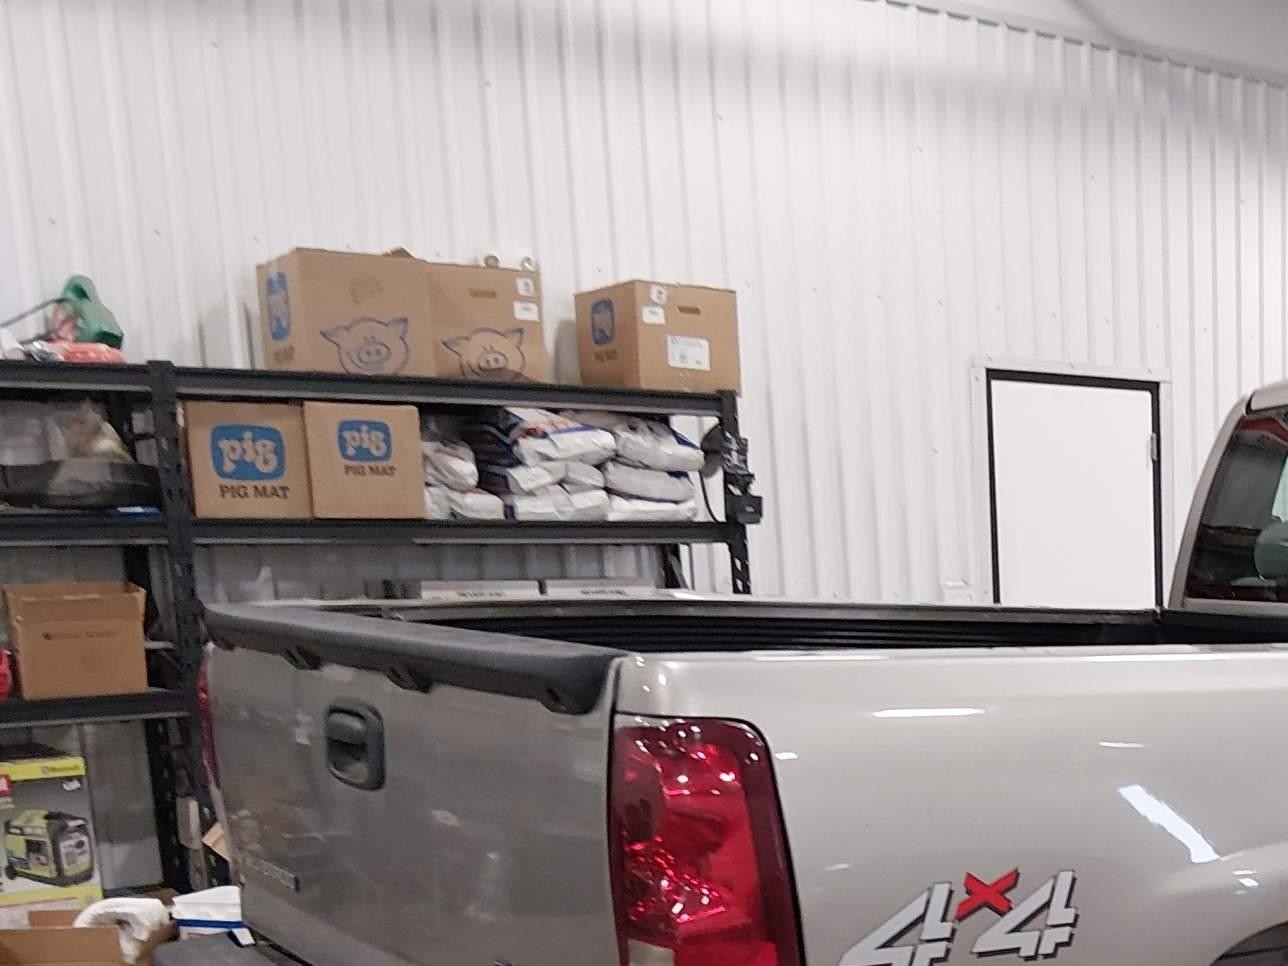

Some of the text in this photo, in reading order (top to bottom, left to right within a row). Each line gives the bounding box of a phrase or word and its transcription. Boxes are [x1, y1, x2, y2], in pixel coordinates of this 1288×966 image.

[217, 430, 279, 474] pig
[341, 423, 388, 456] pig
[343, 464, 397, 477] PIG MAT
[219, 483, 290, 500] PIG MAT
